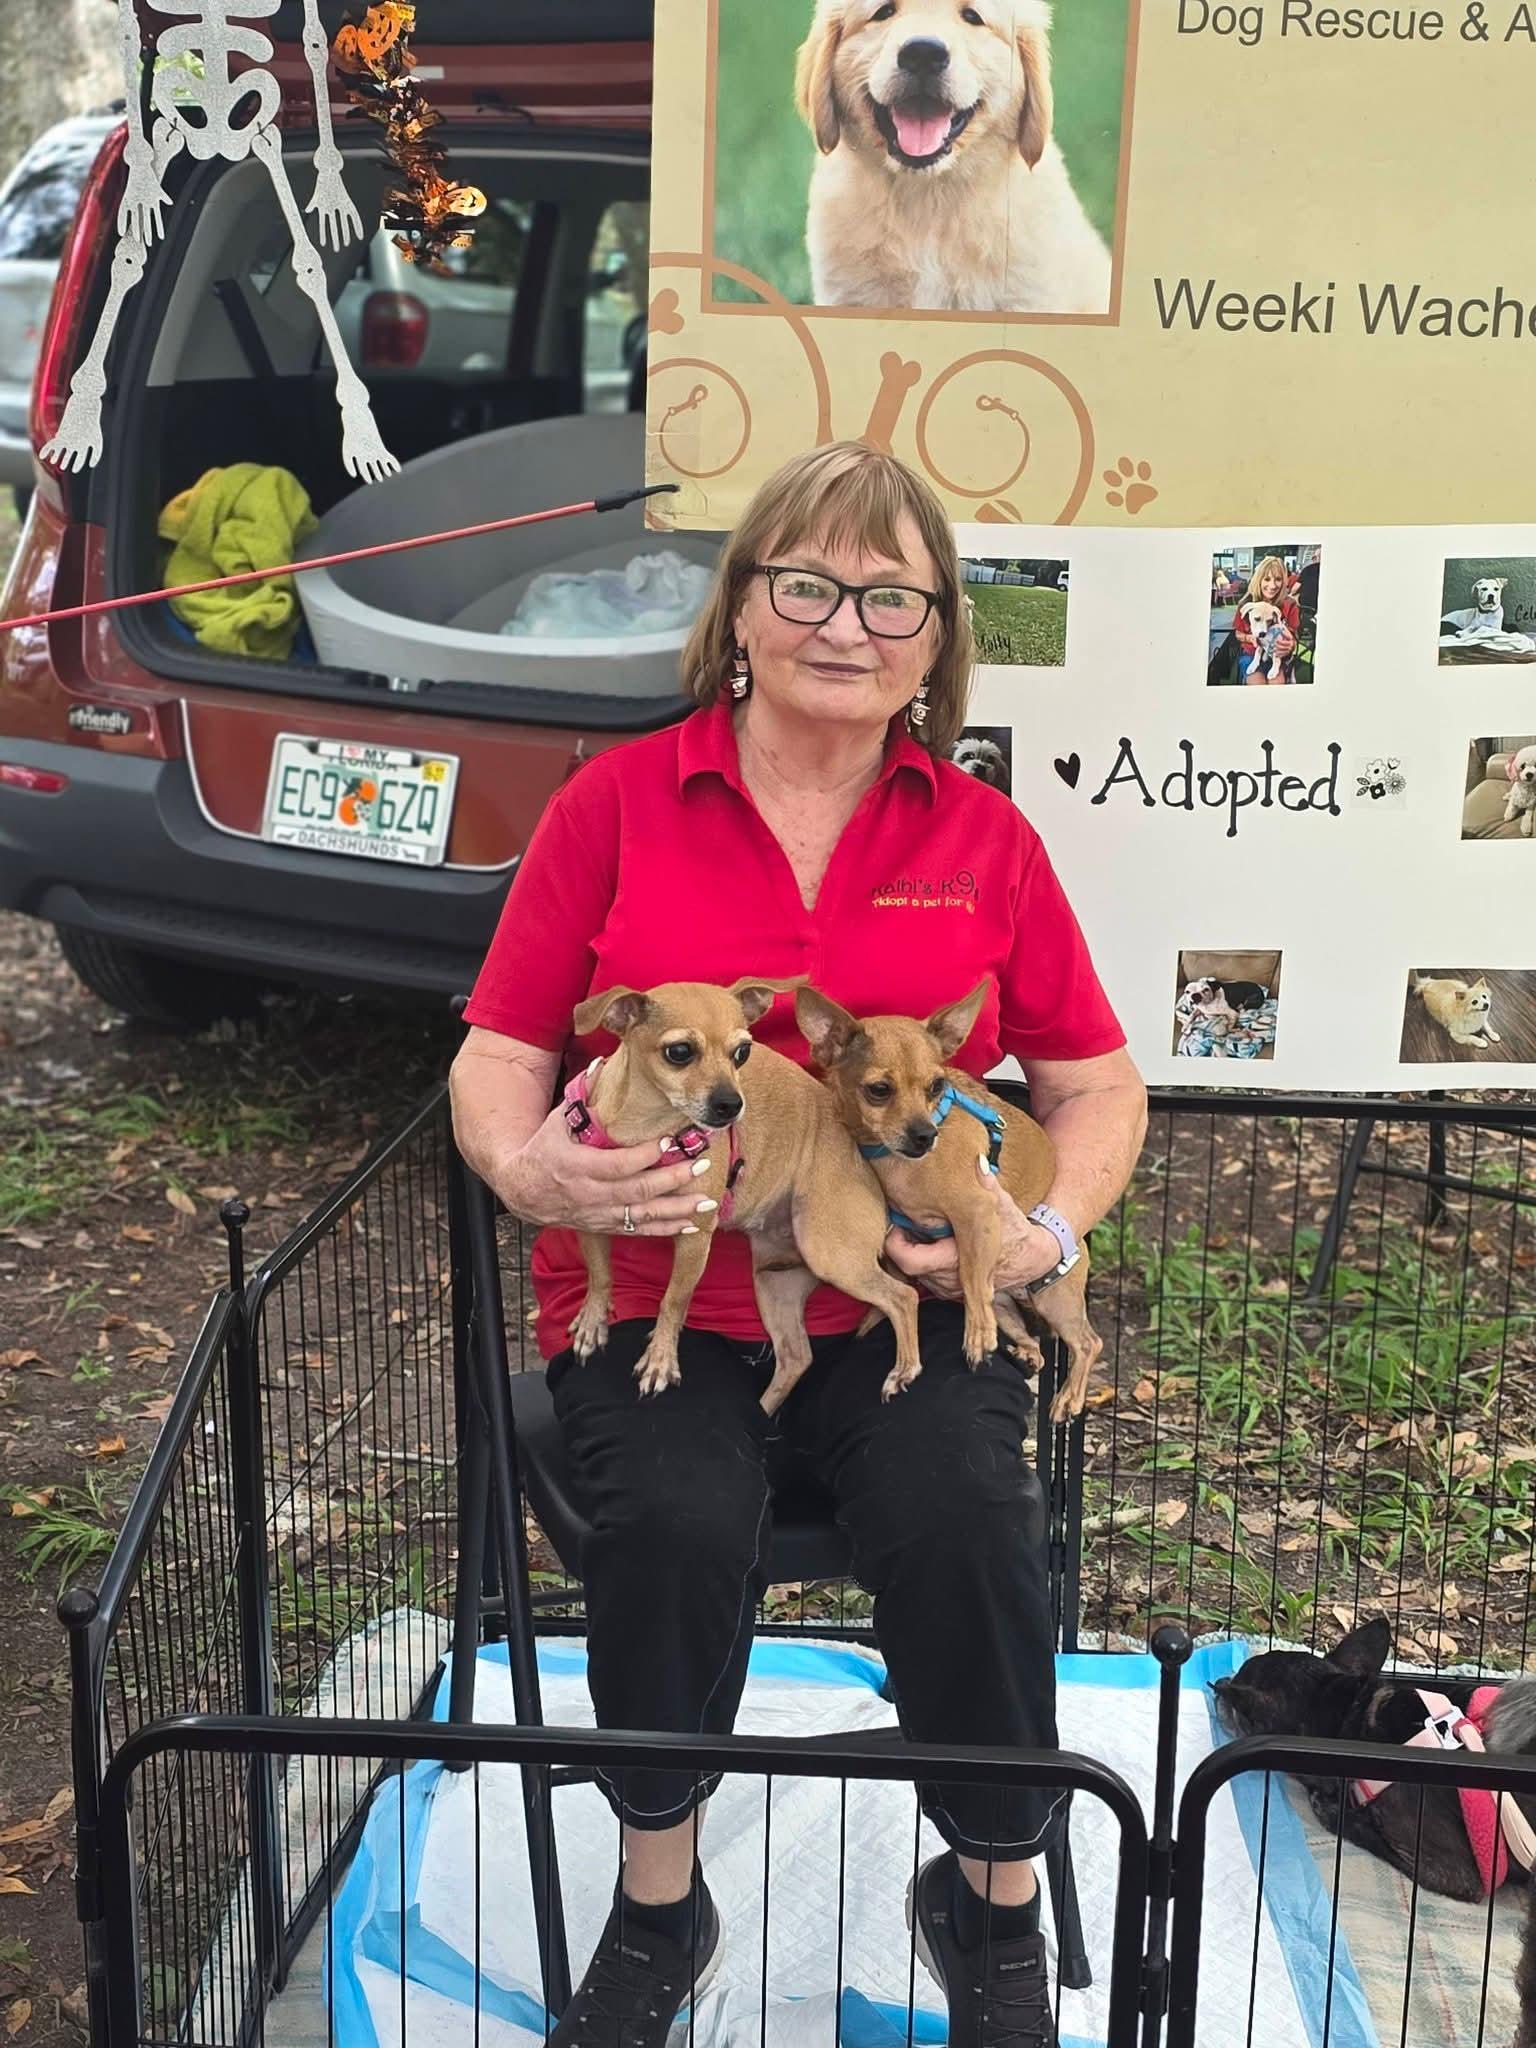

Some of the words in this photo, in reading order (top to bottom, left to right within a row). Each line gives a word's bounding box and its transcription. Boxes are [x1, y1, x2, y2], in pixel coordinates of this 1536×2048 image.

[1177, 0, 1264, 46] Dog
[1281, 0, 1444, 40] Rescue
[1459, 1, 1490, 42] &
[1153, 277, 1336, 333] Weeki
[1358, 283, 1536, 338] Wach
[363, 748, 389, 761] MY
[278, 765, 340, 821] EC9
[376, 779, 440, 836] 6ZQ
[1090, 736, 1342, 838] Adopted
[297, 830, 399, 856] DACHSHUNDS
